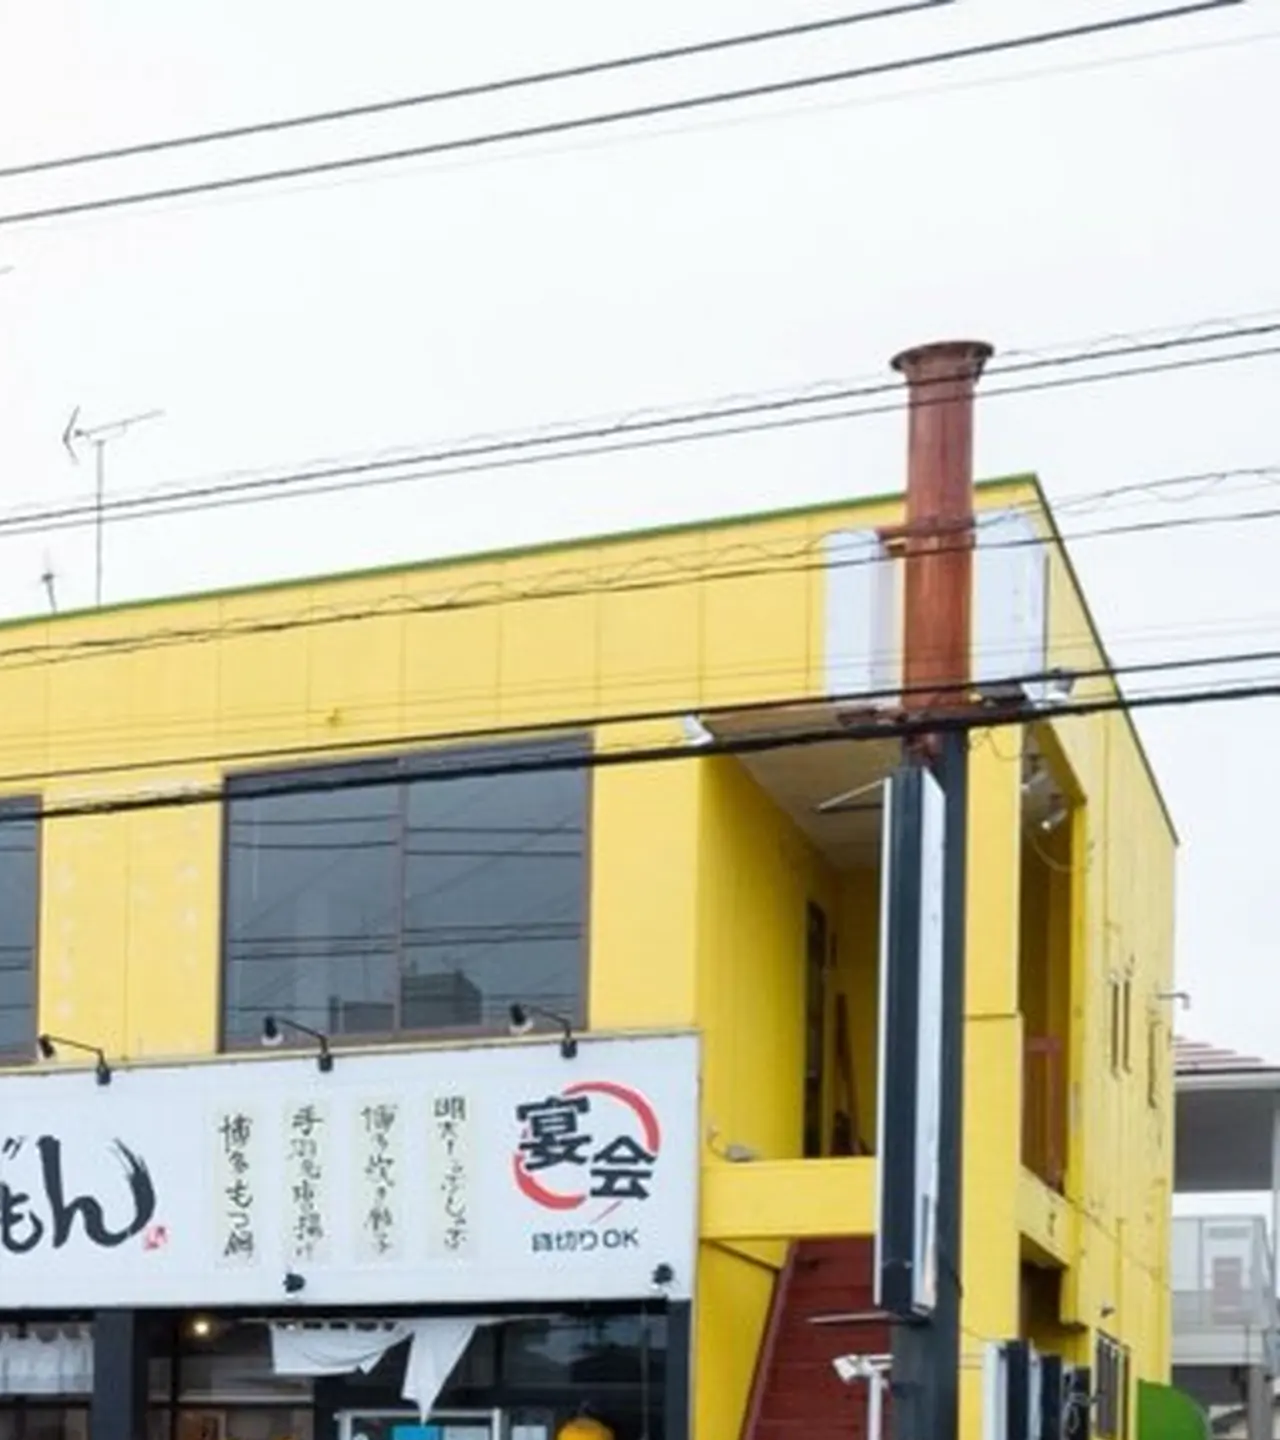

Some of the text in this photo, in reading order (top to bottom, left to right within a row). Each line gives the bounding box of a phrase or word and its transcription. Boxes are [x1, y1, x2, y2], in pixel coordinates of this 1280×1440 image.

[219, 1113, 254, 1258] 博多もつ鍋
[516, 1095, 656, 1200] 宴会
